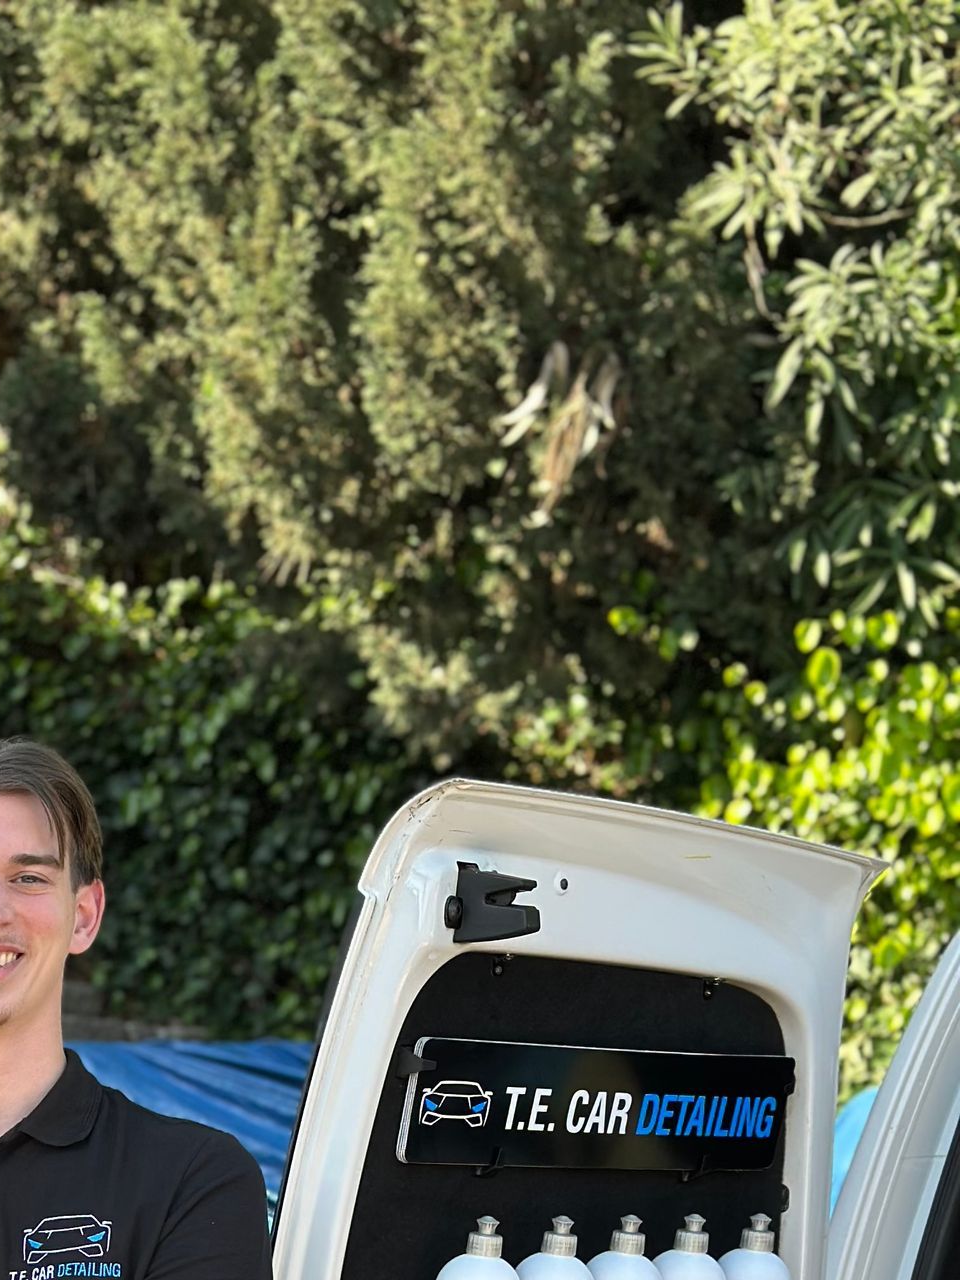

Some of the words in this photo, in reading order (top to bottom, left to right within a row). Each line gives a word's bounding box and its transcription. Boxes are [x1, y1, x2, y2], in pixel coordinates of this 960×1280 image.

[504, 1086, 555, 1132] T.E.
[565, 1089, 633, 1135] CAR
[636, 1093, 777, 1138] DETAILING
[57, 1262, 121, 1278] DETAILING
